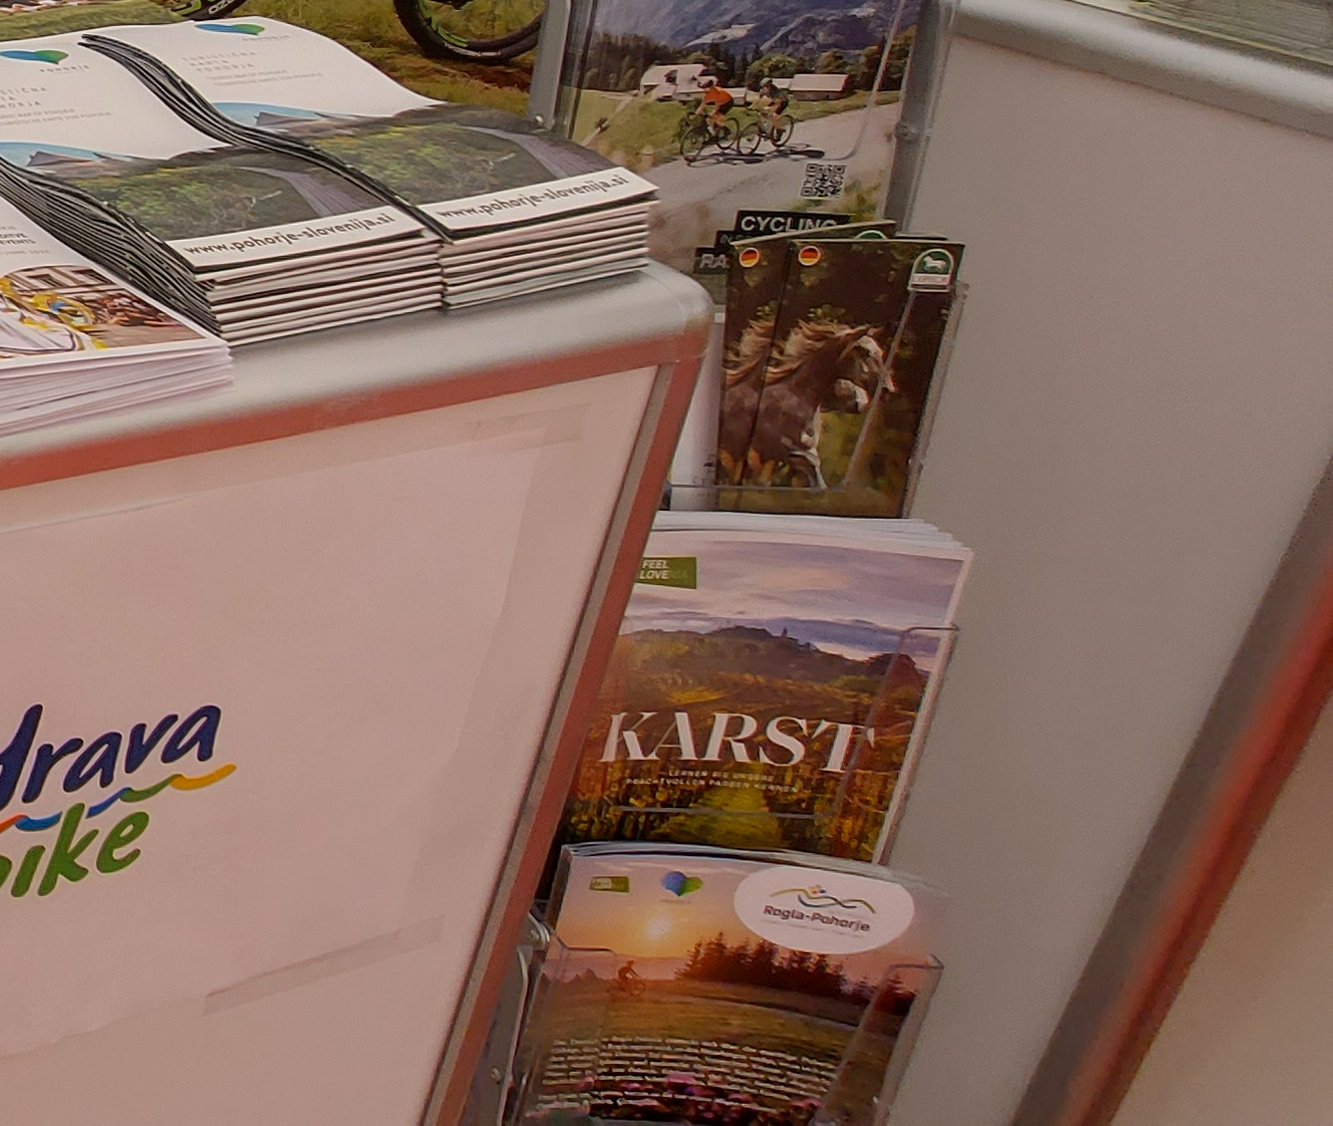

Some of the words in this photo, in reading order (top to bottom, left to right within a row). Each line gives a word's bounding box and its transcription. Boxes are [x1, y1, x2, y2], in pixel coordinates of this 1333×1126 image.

[439, 174, 628, 220] www.pohorje-slovenija.si
[183, 213, 396, 256] www.pohorje-slovenija.si
[642, 560, 669, 568] FEEL
[599, 710, 875, 774] KARST
[763, 903, 871, 934] Rogla-Pohorje
